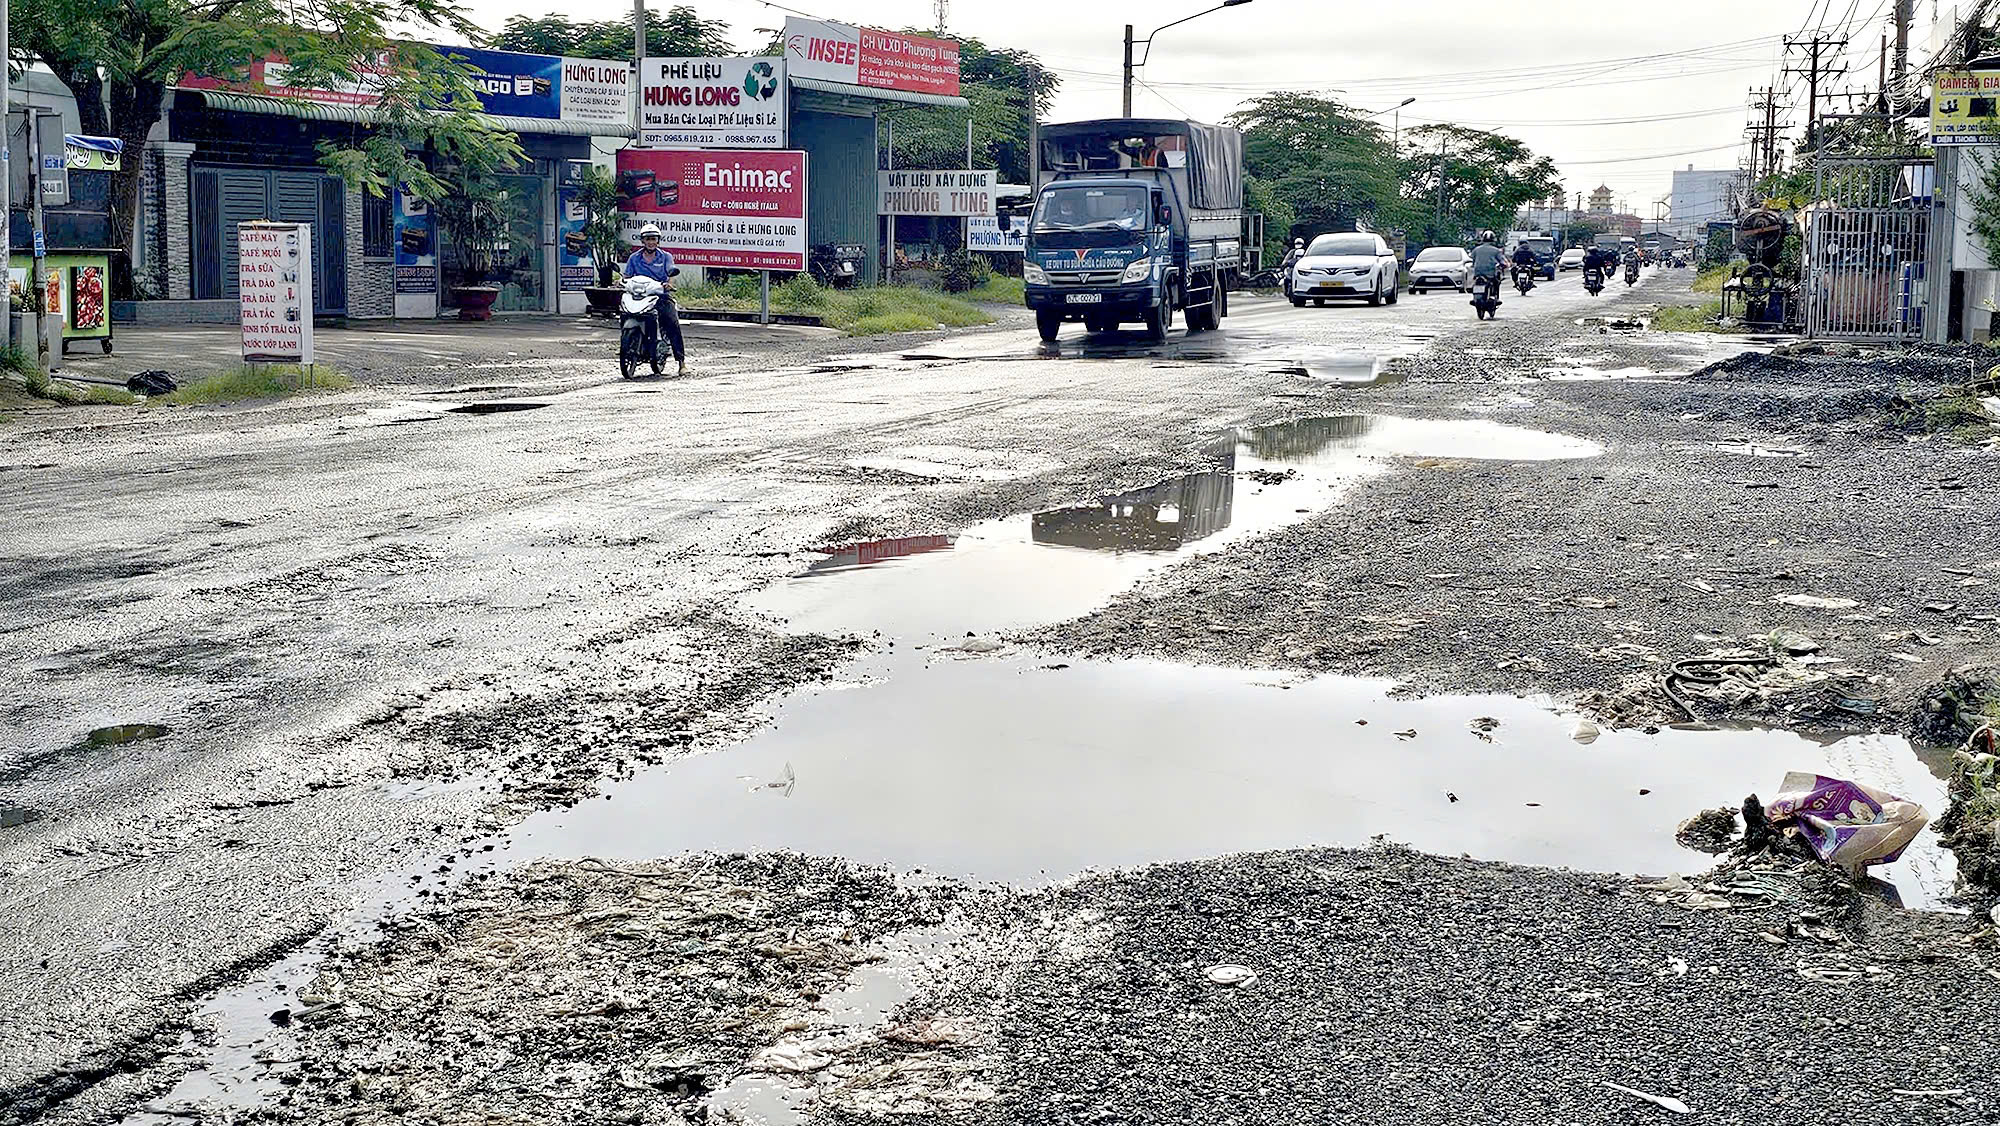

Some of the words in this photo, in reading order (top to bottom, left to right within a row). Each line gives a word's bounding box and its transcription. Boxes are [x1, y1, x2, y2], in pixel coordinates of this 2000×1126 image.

[808, 37, 857, 65] INSEE
[862, 35, 875, 49] CH
[878, 37, 900, 53] VLXD
[599, 67, 626, 84] LONG
[661, 61, 689, 79] PHẾ
[692, 62, 722, 81] LIỆU
[1940, 78, 1980, 89] CAMERA
[644, 85, 692, 106] HƯNG
[695, 86, 740, 106] LONG
[645, 113, 661, 124] Mua
[664, 113, 679, 125] Bán
[682, 113, 696, 125] Các
[699, 113, 716, 127] Loại
[719, 112, 734, 125] Phế
[736, 113, 754, 128] Liệu
[704, 163, 792, 188] Enimac
[889, 173, 907, 190] VẬT
[911, 173, 931, 189] LIỆU
[936, 172, 955, 187] XÂY
[760, 202, 779, 210] ITALIA
[951, 189, 988, 212] TÙNG
[671, 220, 692, 232] PHÂN
[695, 220, 714, 233] PHỐI
[727, 224, 733, 233] &
[749, 223, 771, 235] HƯNG
[775, 225, 797, 236] LONG
[241, 262, 256, 272] TRÀ
[242, 278, 257, 288] TRÀ
[242, 292, 257, 303] TRÀ
[243, 308, 257, 318] TRÀ
[279, 341, 297, 351] LẠNH
